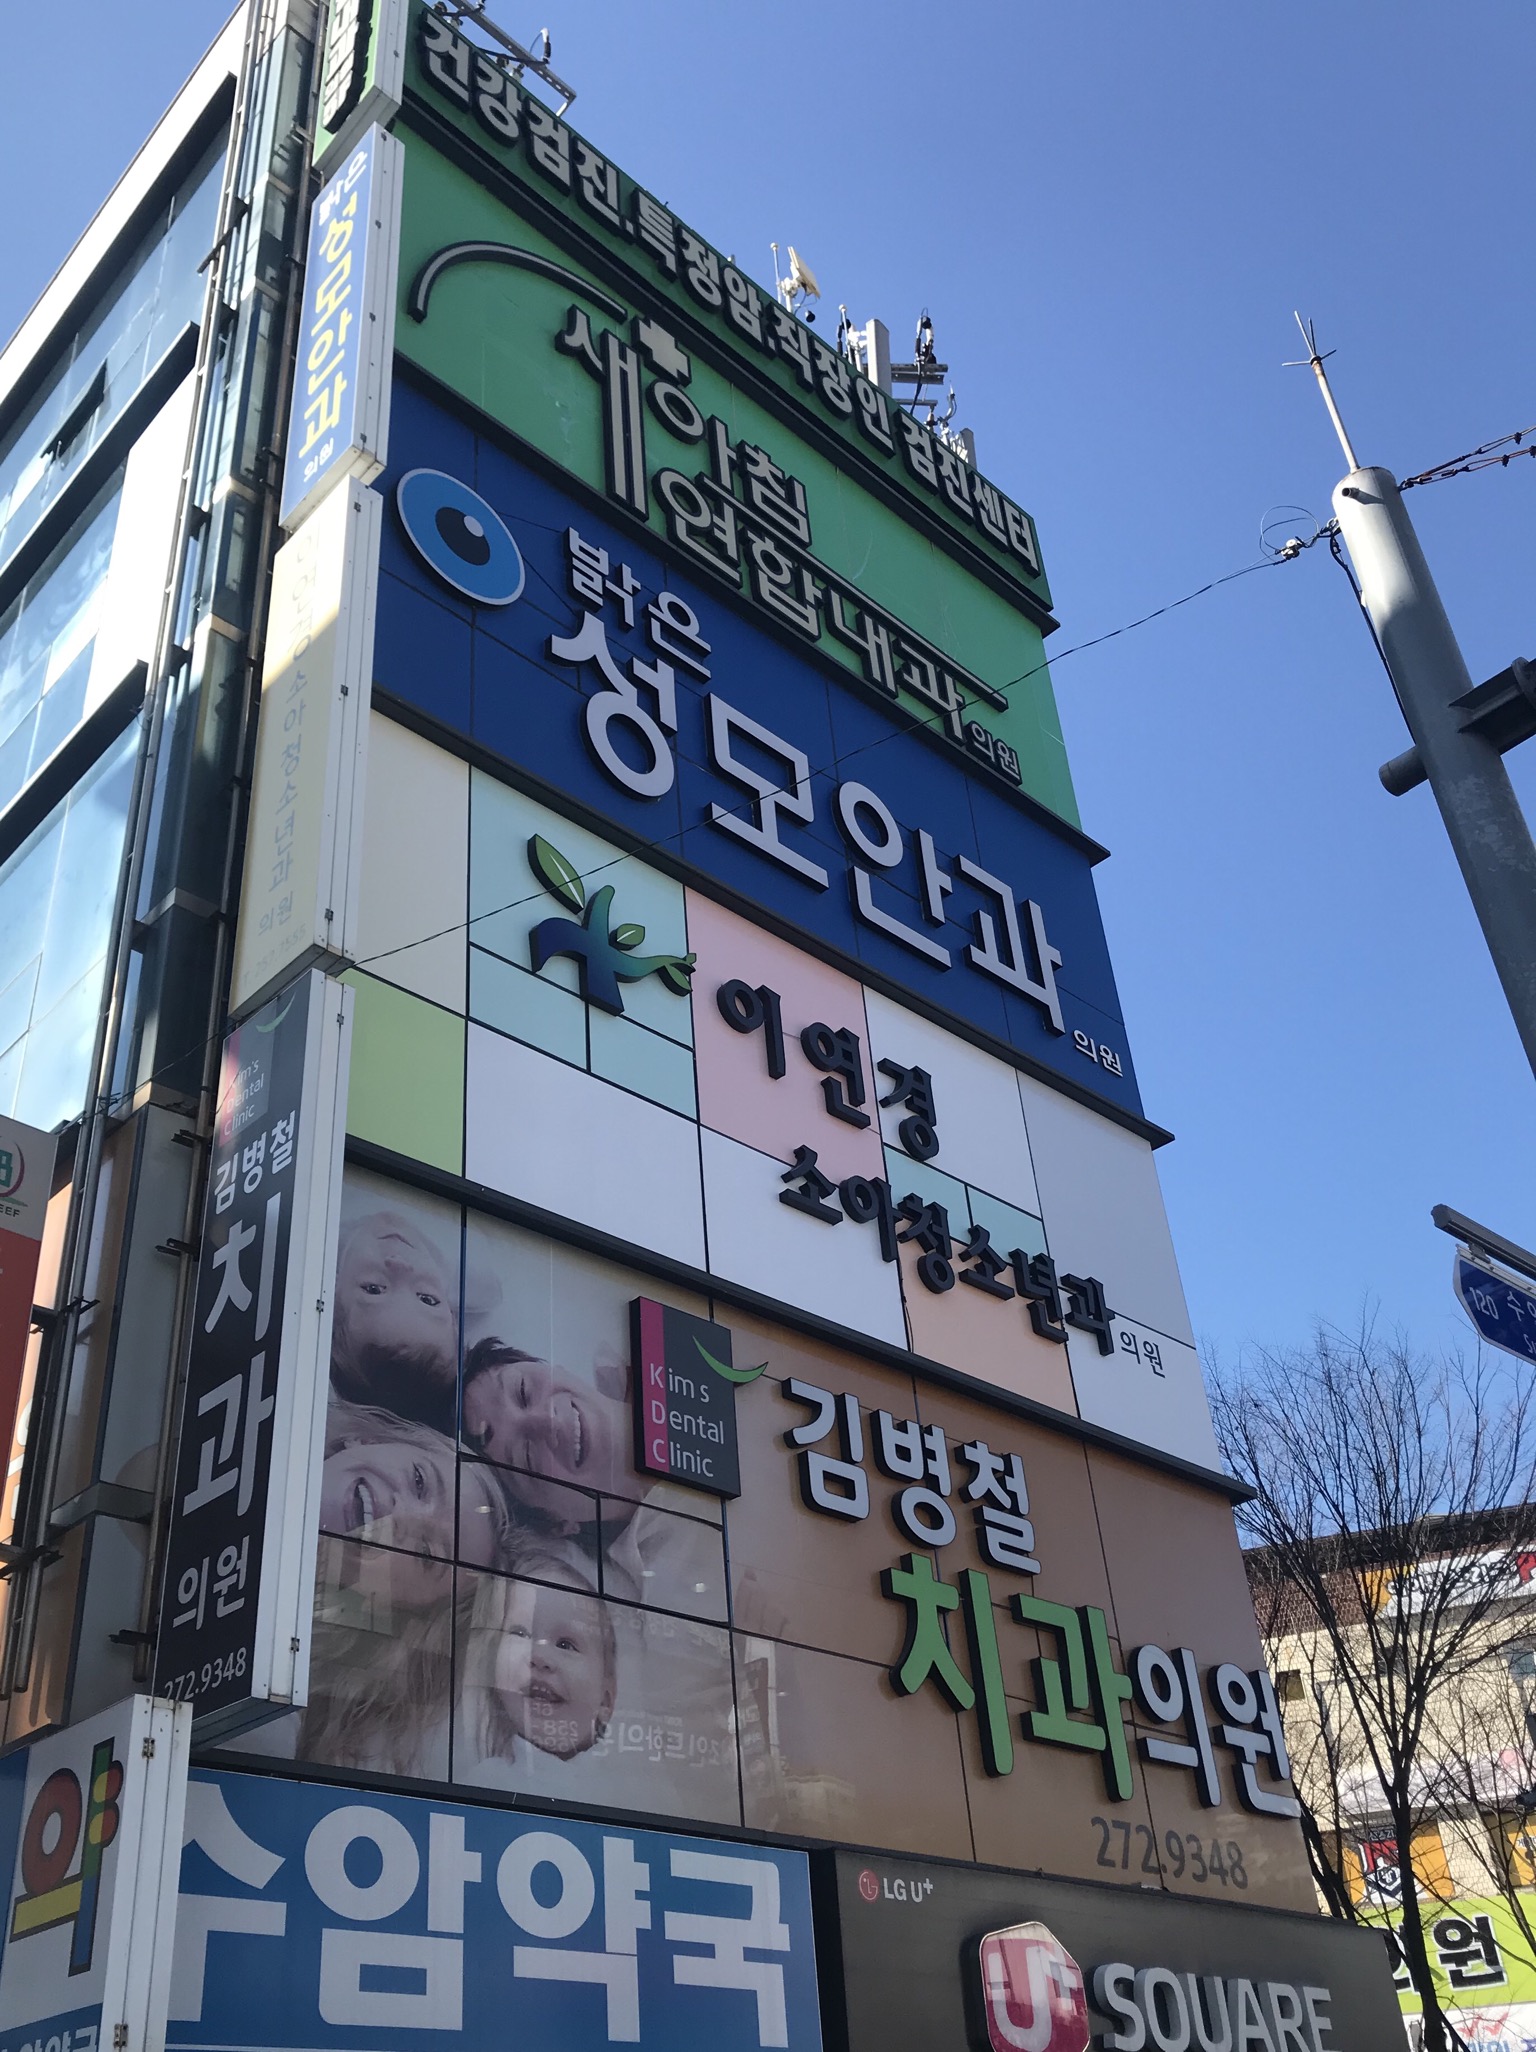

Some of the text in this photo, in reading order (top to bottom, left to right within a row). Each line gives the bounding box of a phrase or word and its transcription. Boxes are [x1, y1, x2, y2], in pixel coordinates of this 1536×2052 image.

[298, 191, 357, 458] 성모안과
[556, 304, 811, 546] 새아침
[896, 408, 1041, 578] 검진센터
[566, 527, 712, 684] 밝은
[652, 467, 1022, 785] 연합내과 의원
[258, 890, 294, 937] 의원
[545, 610, 1123, 1077] 성모안과 의원
[716, 979, 939, 1161] 이연경
[214, 1110, 295, 1215] 김병철
[779, 1145, 1165, 1378] 소아청소년과 의원
[1469, 1287, 1499, 1320] 120
[182, 1191, 281, 1517] 치과
[651, 1400, 724, 1445] Dental
[652, 1439, 714, 1477] Clinic
[782, 1377, 1040, 1576] 김병철
[173, 1535, 250, 1630] 의원
[164, 1647, 247, 1700] 272.9348
[880, 1553, 1300, 1819] 치과의원
[883, 1878, 934, 1903] LG U+
[1090, 1816, 1247, 1890] 272.9348
[1093, 1962, 1341, 2052] SQUARE
